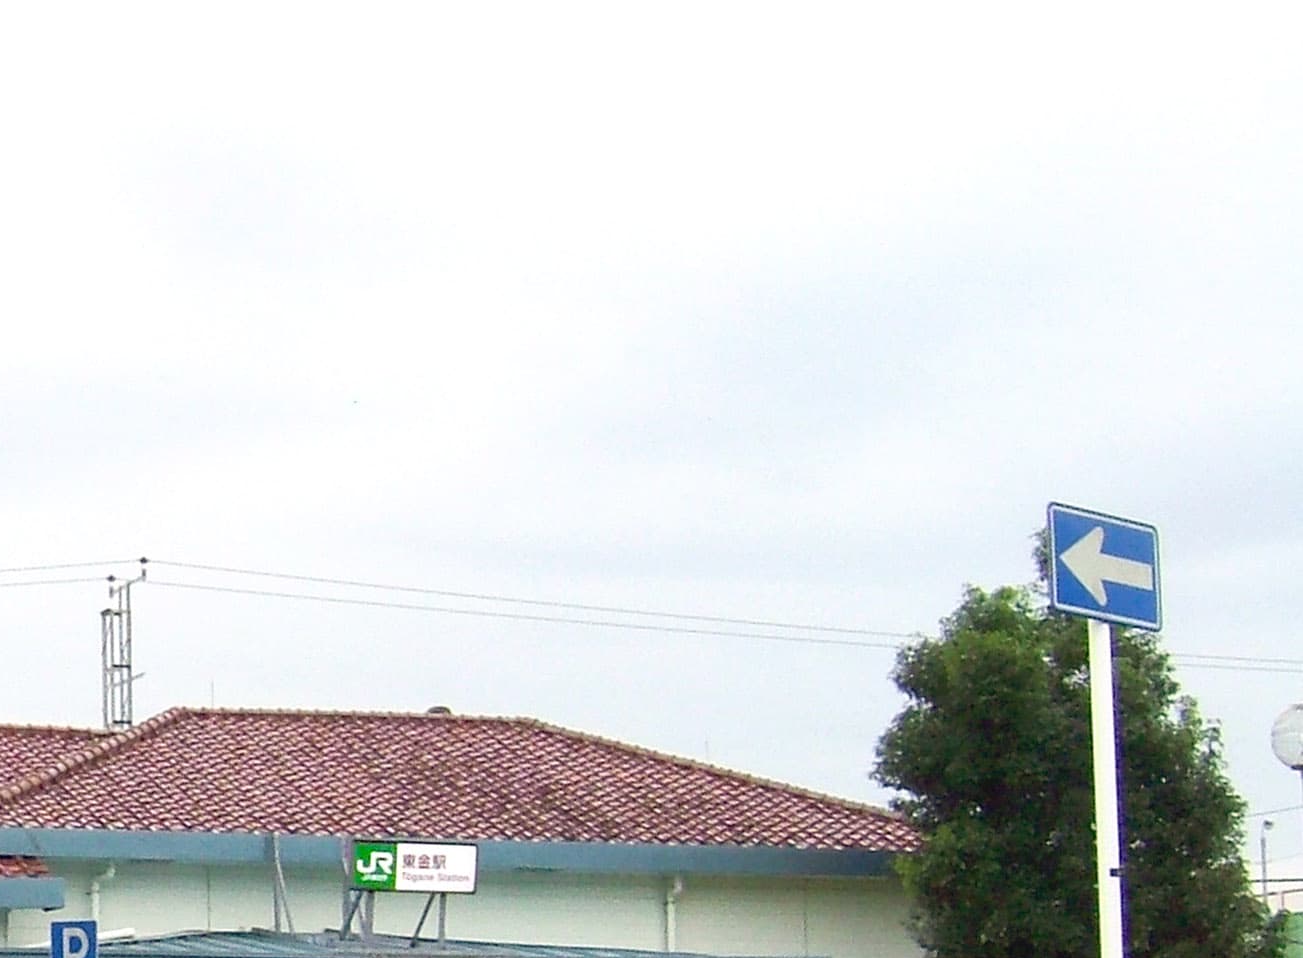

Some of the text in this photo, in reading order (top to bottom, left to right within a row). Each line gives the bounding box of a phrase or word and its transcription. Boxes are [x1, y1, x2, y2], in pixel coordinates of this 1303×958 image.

[356, 851, 393, 874] JR
[402, 854, 447, 870] 東金駅
